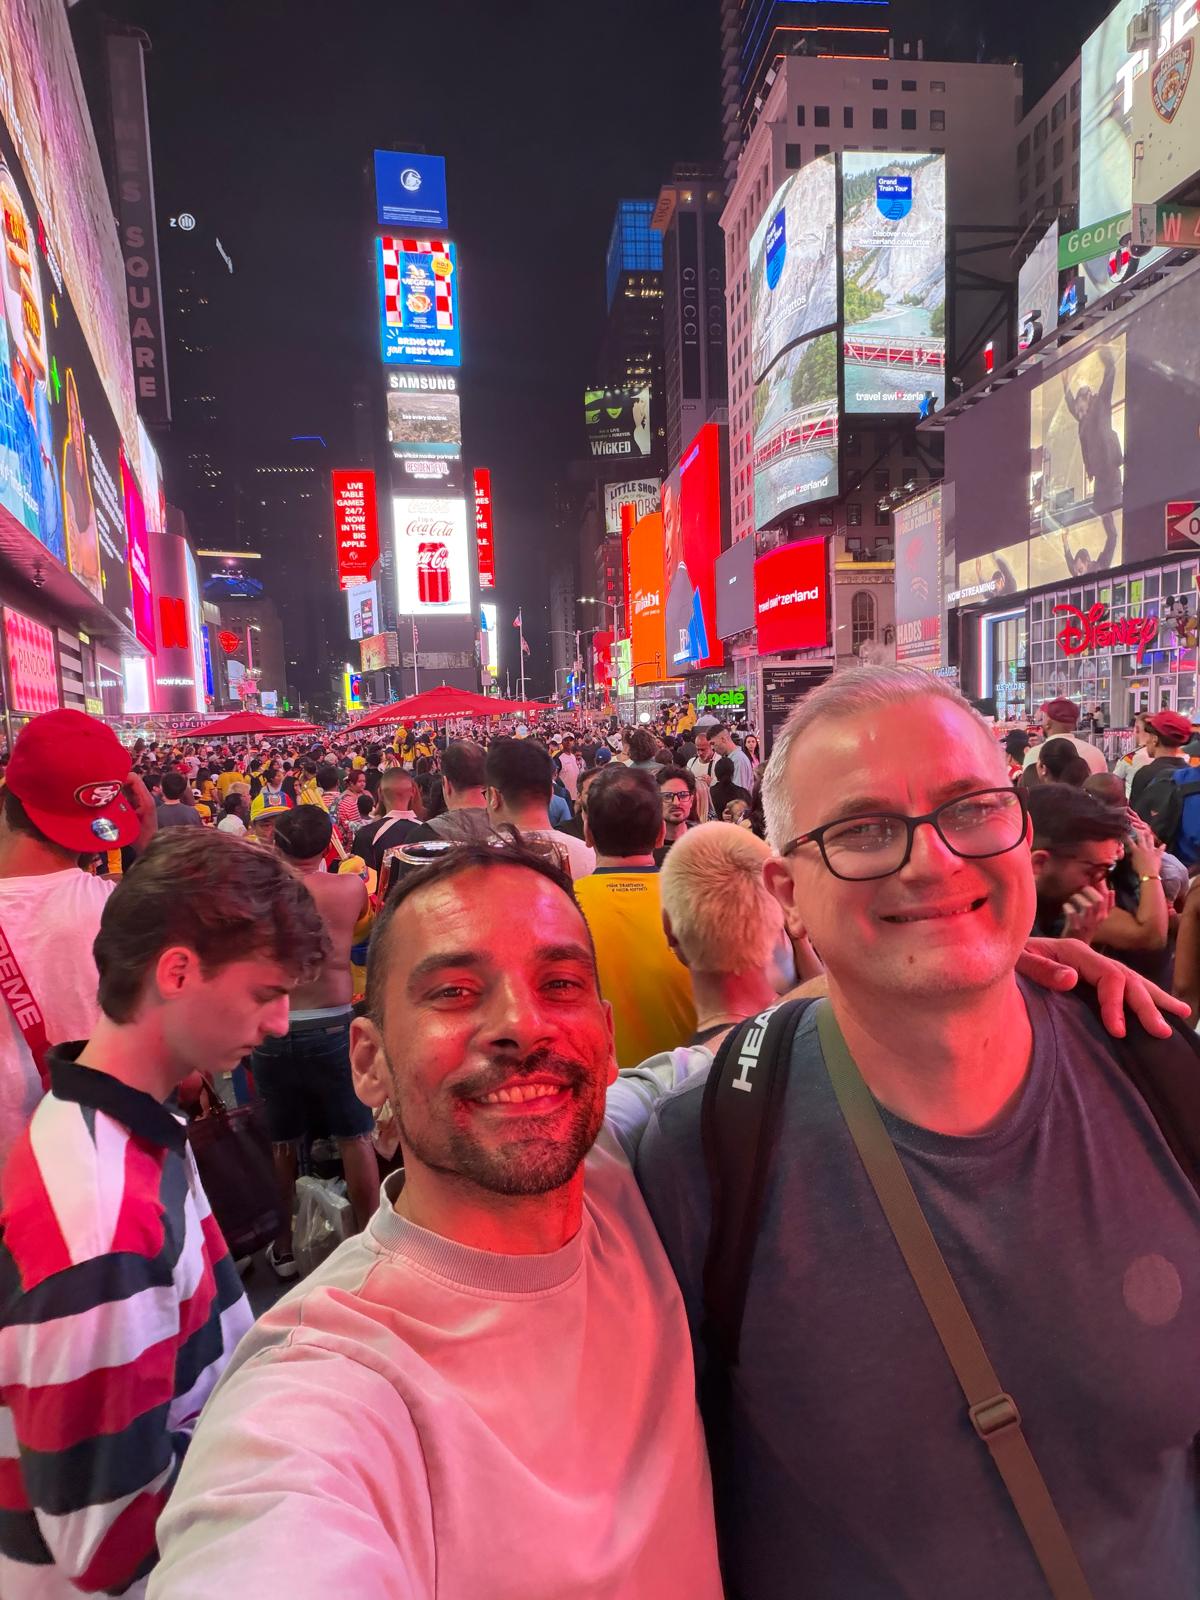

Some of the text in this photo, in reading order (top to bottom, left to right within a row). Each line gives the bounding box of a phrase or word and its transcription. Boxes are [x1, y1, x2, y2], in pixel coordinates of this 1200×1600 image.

[125, 226, 156, 397] SQUARE
[682, 267, 697, 345] GUCCI
[397, 337, 446, 347] BRING OUT
[405, 346, 427, 355] BEST
[428, 348, 454, 357] GAME
[390, 375, 456, 391] SAMSUNG
[856, 390, 935, 401] travel switzerla
[347, 482, 364, 490] LIVE
[610, 482, 657, 499] LITTLE SHOP
[336, 499, 365, 507] GAMES
[611, 497, 657, 520] HOORS
[353, 532, 367, 540] BIG
[961, 580, 996, 598] STREAMING
[18, 647, 50, 680] PANDORA
[708, 683, 746, 707] pelé
[378, 709, 474, 723] TIMES SQUARE
[731, 1000, 788, 1093] HEA
